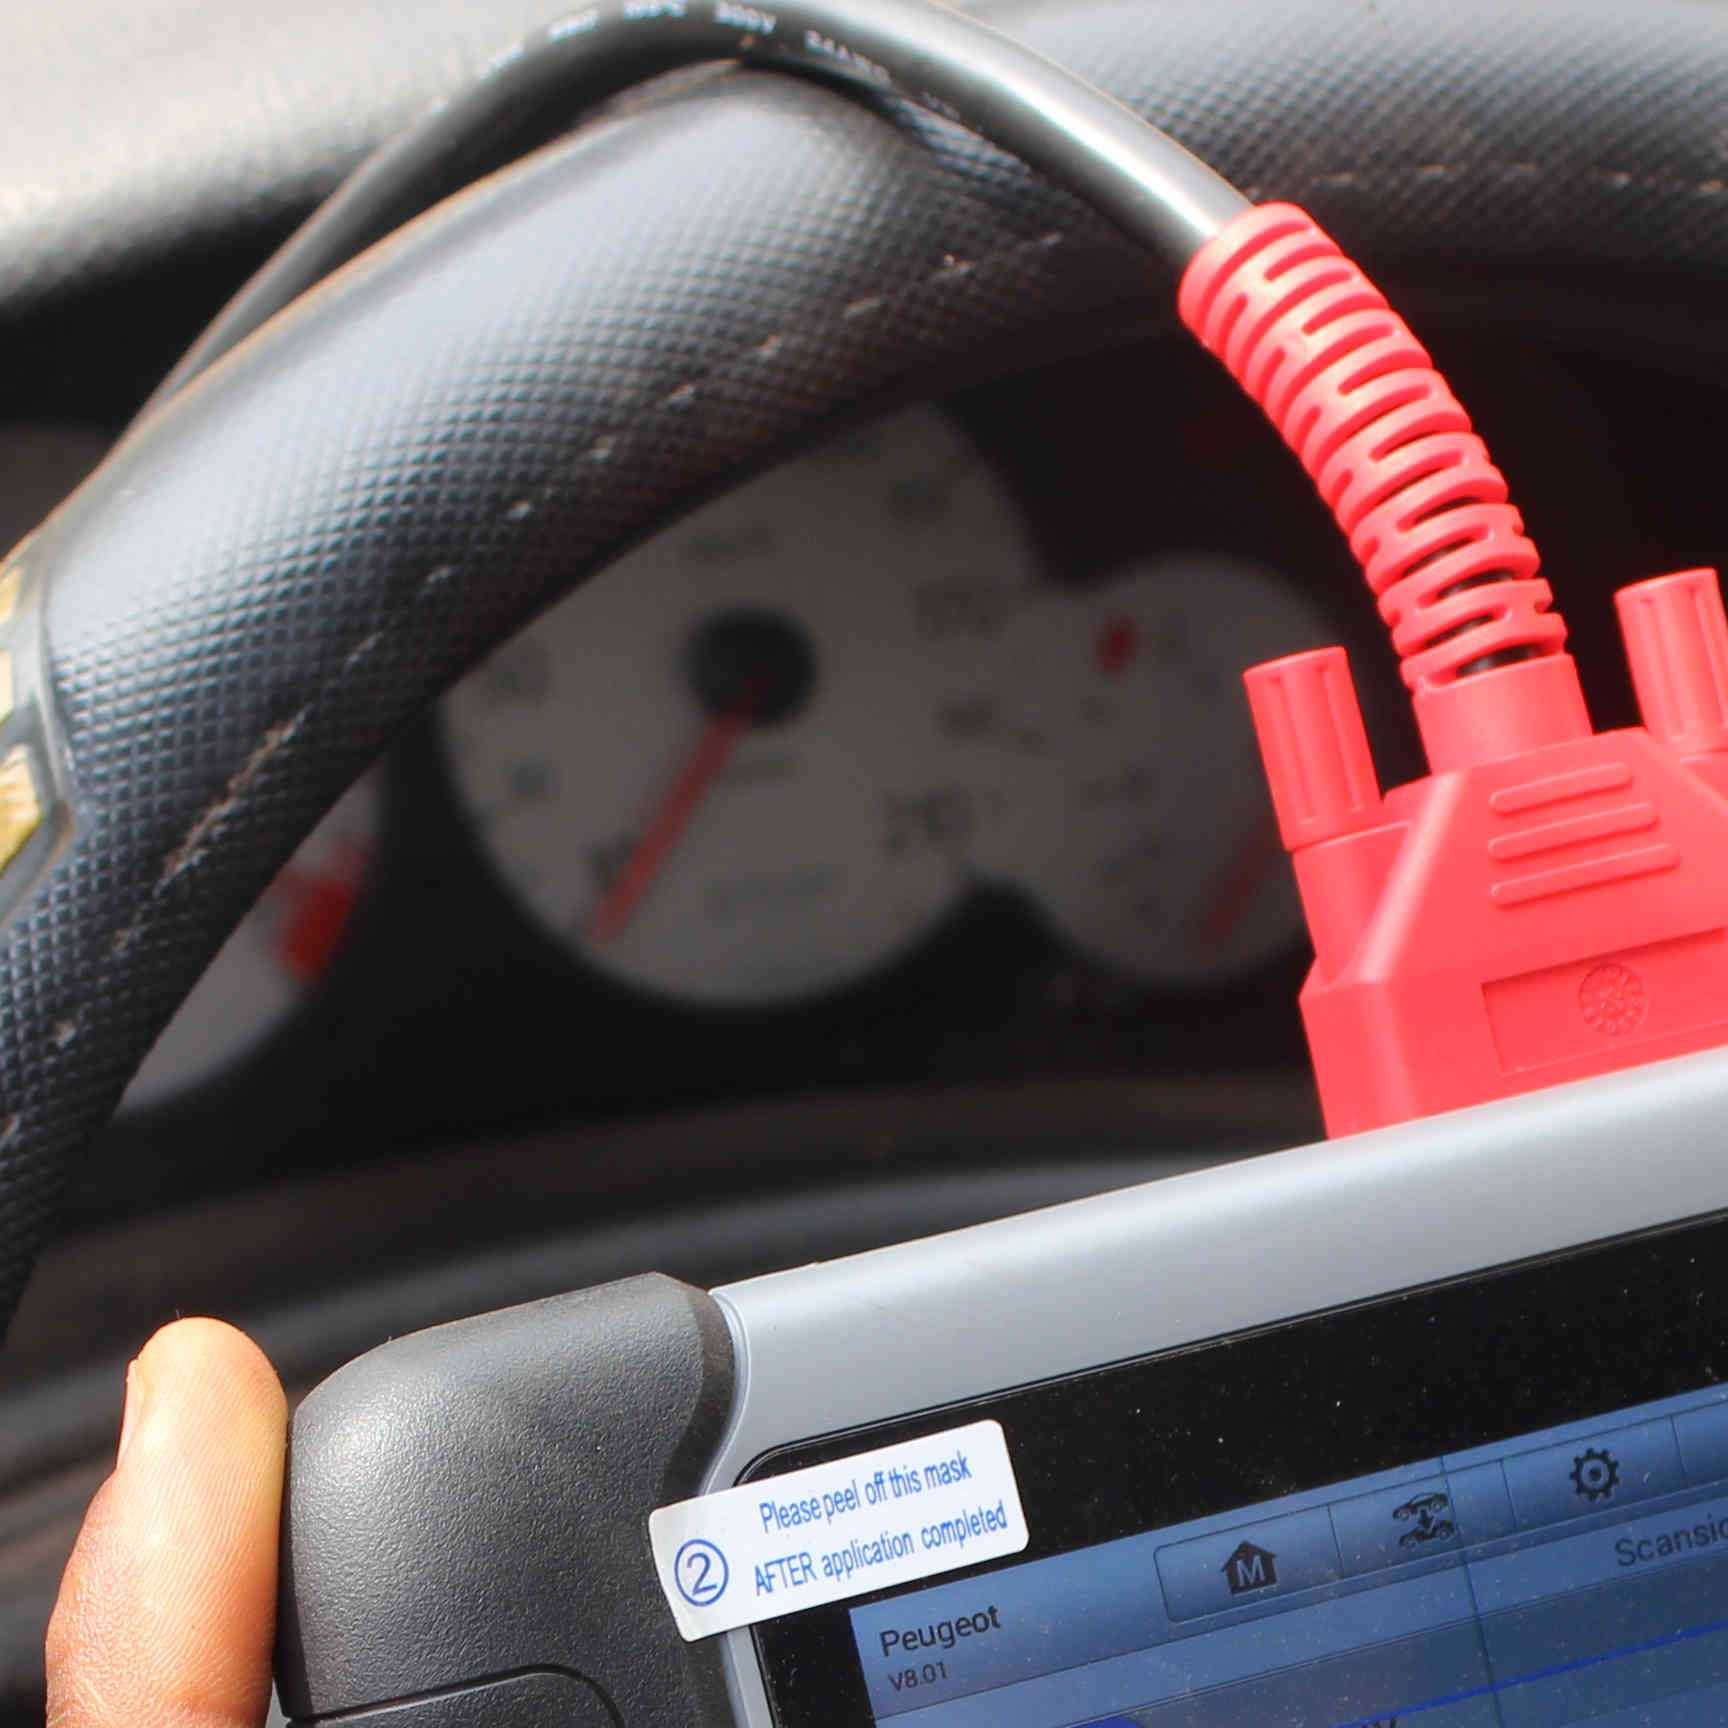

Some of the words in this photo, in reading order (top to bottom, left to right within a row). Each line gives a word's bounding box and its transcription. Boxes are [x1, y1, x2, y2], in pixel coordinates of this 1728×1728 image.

[759, 1491, 822, 1534] Please
[823, 1482, 862, 1527] peel
[863, 1474, 892, 1503] off
[892, 1465, 923, 1500] this
[921, 1451, 972, 1493] mask
[754, 1553, 817, 1598] AFTER
[822, 1530, 915, 1582] application
[920, 1503, 1008, 1554] completed
[879, 1603, 1002, 1657] Peugeot
[888, 1659, 950, 1693] V8.01
